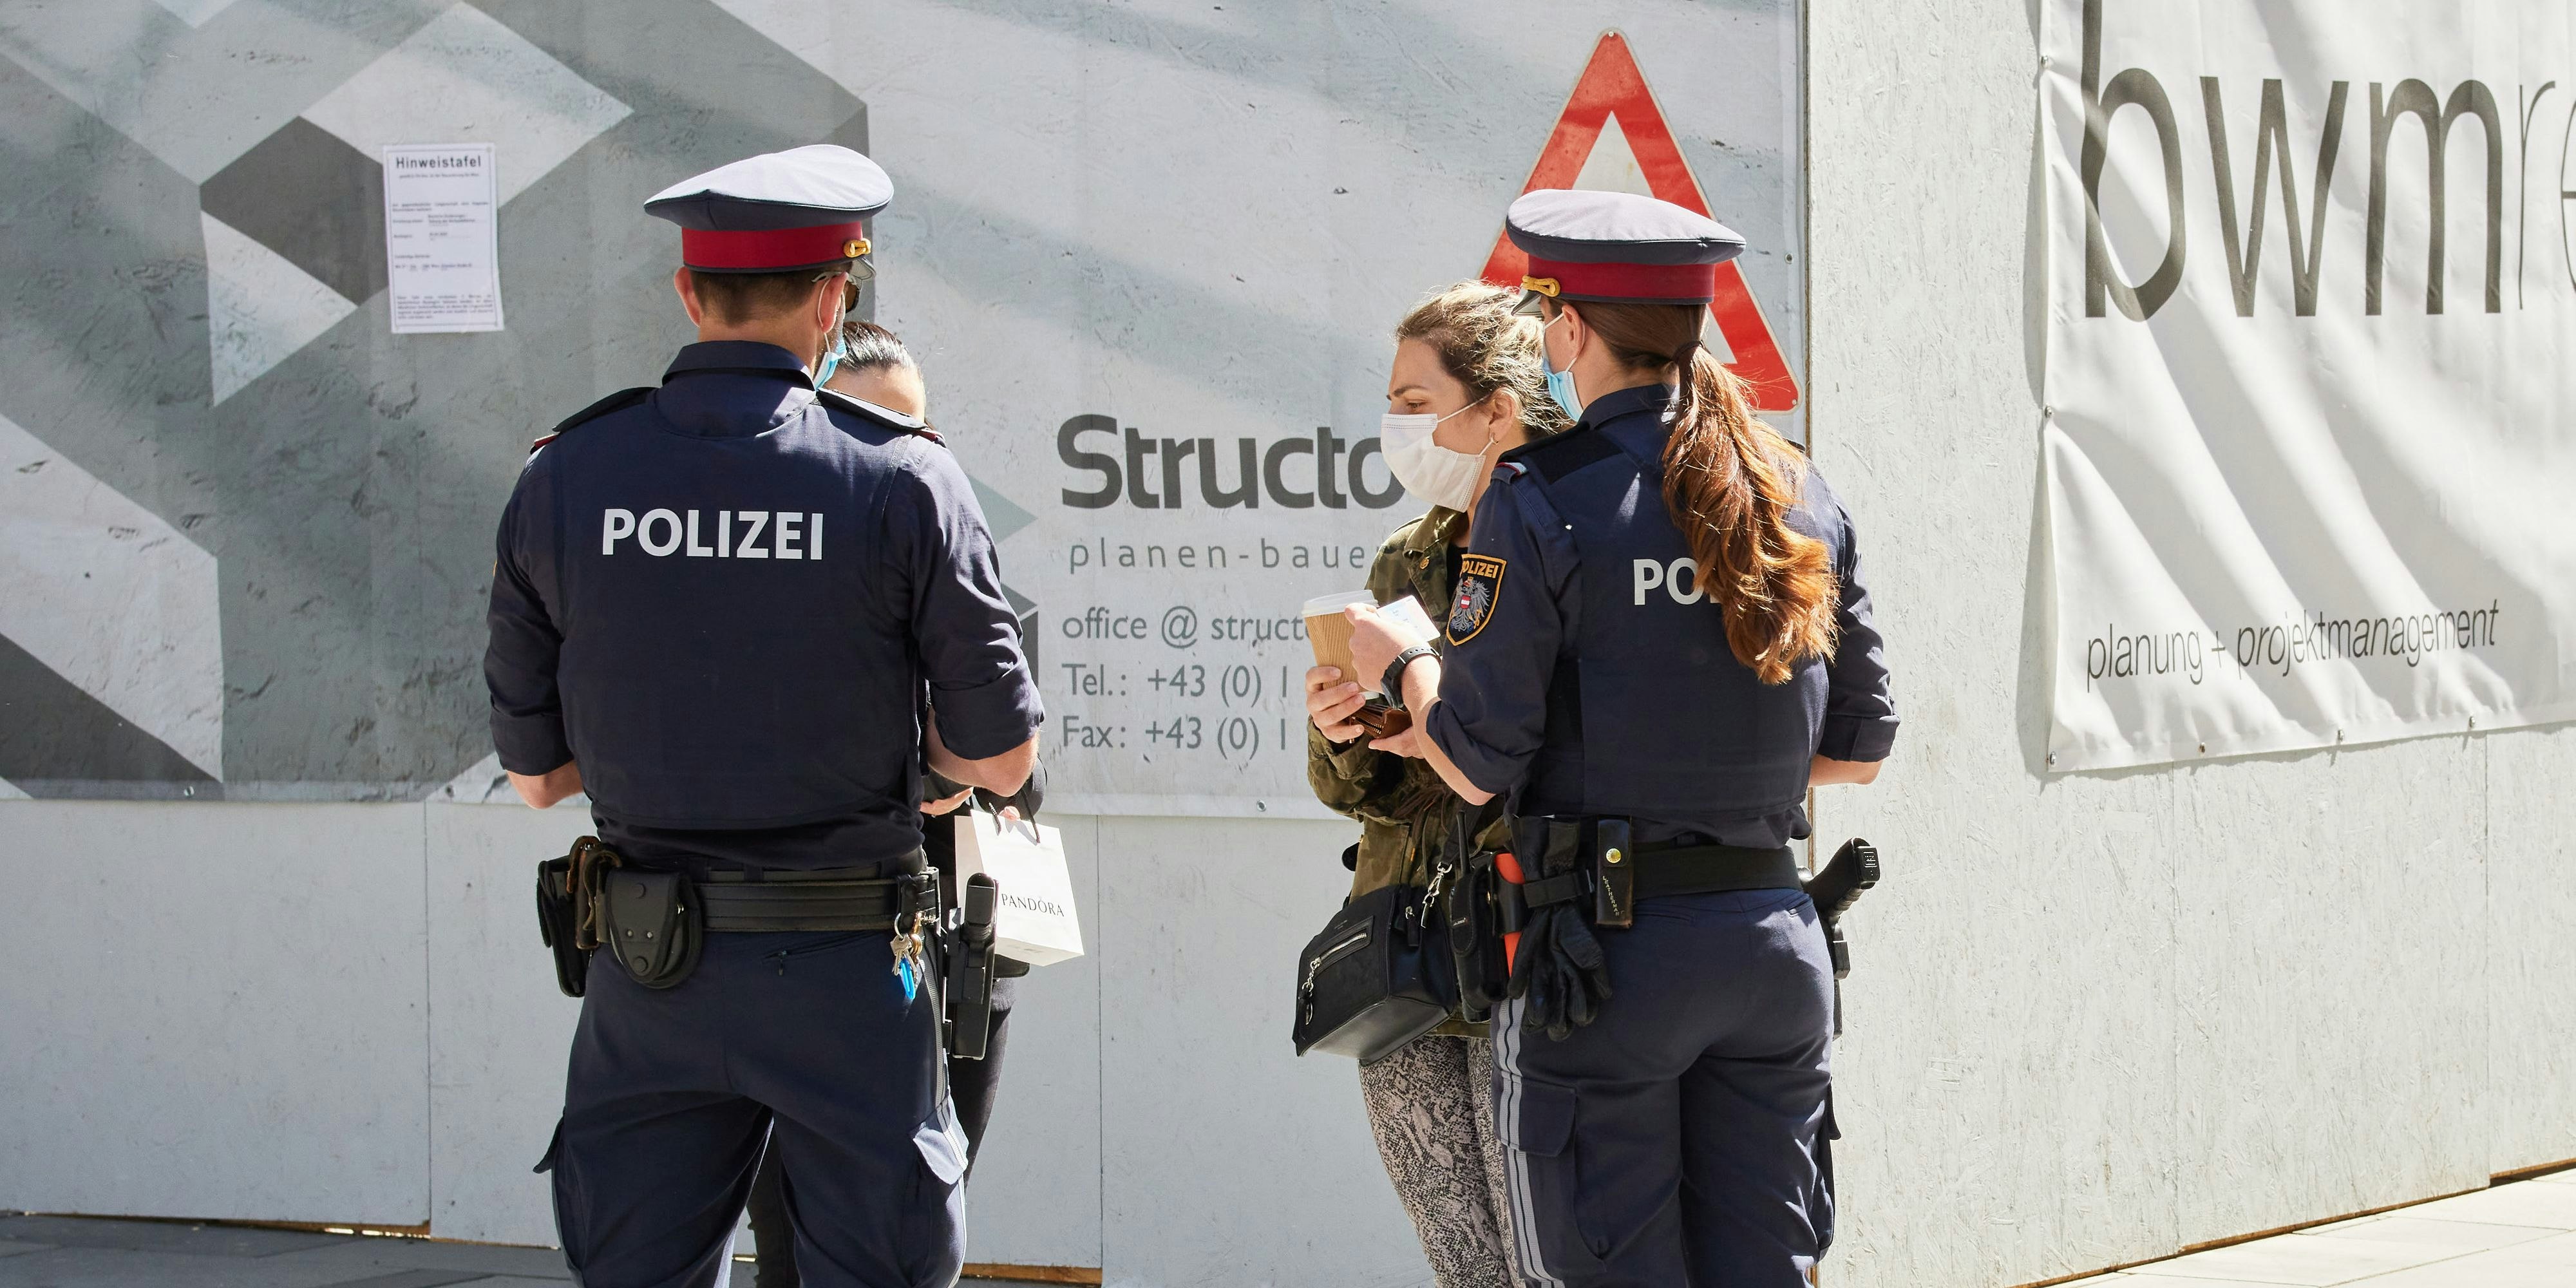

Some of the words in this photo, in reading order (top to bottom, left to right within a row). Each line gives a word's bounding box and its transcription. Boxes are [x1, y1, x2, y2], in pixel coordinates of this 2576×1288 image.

[396, 155, 482, 169] Hinweistafel
[2081, 0, 2576, 321] bwmr
[1057, 413, 1406, 509] Structo
[602, 508, 824, 560] POLIZEI
[1070, 537, 1379, 574] planen-baue
[1634, 557, 1725, 605] PO
[1062, 606, 1147, 639] office
[1161, 605, 1197, 649] @
[1211, 616, 1310, 641] struct
[2087, 623, 2202, 693] planung
[2211, 631, 2226, 668] +
[2237, 598, 2499, 679] projektmanagement
[1061, 663, 1126, 696] Tel.:
[1148, 665, 1206, 697] +43
[1221, 665, 1262, 708] (0)
[1063, 715, 1126, 748] Fax:
[1145, 716, 1202, 750] +43
[1217, 717, 1259, 761] (0)
[1001, 893, 1064, 917] PANDORA
